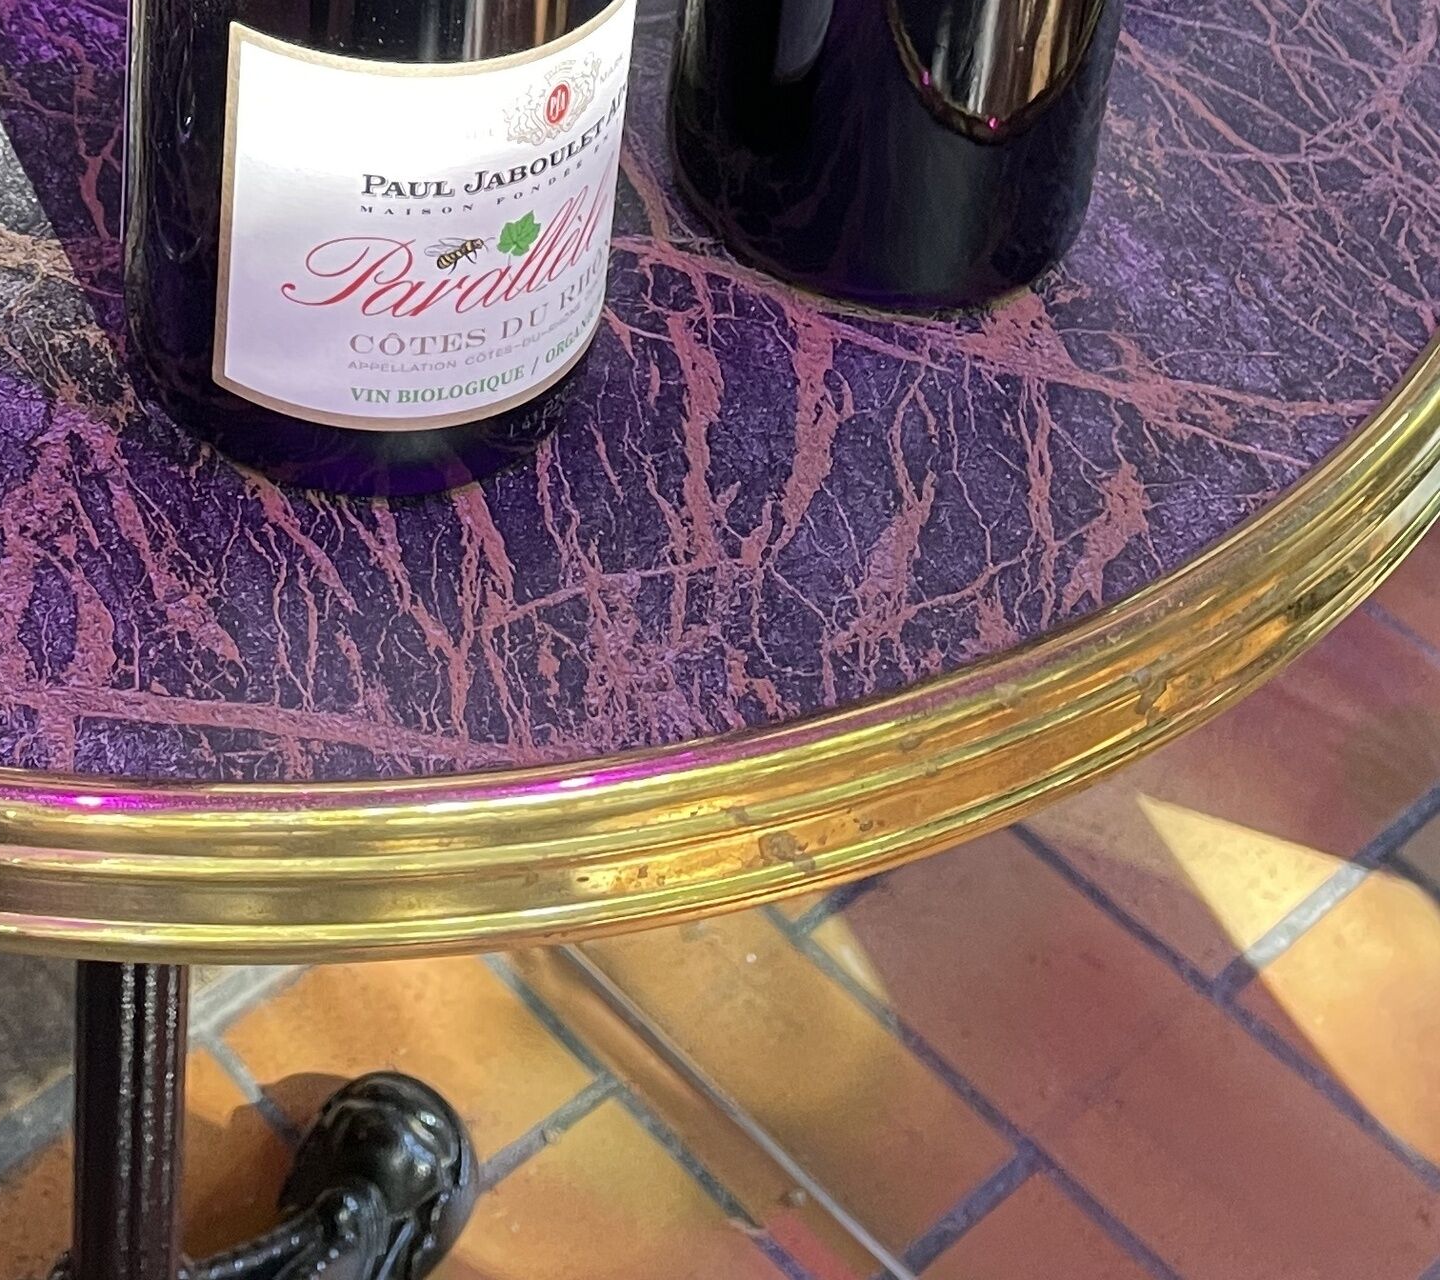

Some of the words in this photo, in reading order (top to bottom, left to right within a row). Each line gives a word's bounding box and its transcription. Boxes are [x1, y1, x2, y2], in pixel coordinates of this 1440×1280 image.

[361, 172, 456, 200] PAUL
[464, 114, 606, 196] JABOULET
[349, 326, 487, 358] CÔTES
[501, 301, 549, 340] DU
[351, 385, 391, 404] VIN
[397, 363, 526, 404] BIOLOGIQUE
